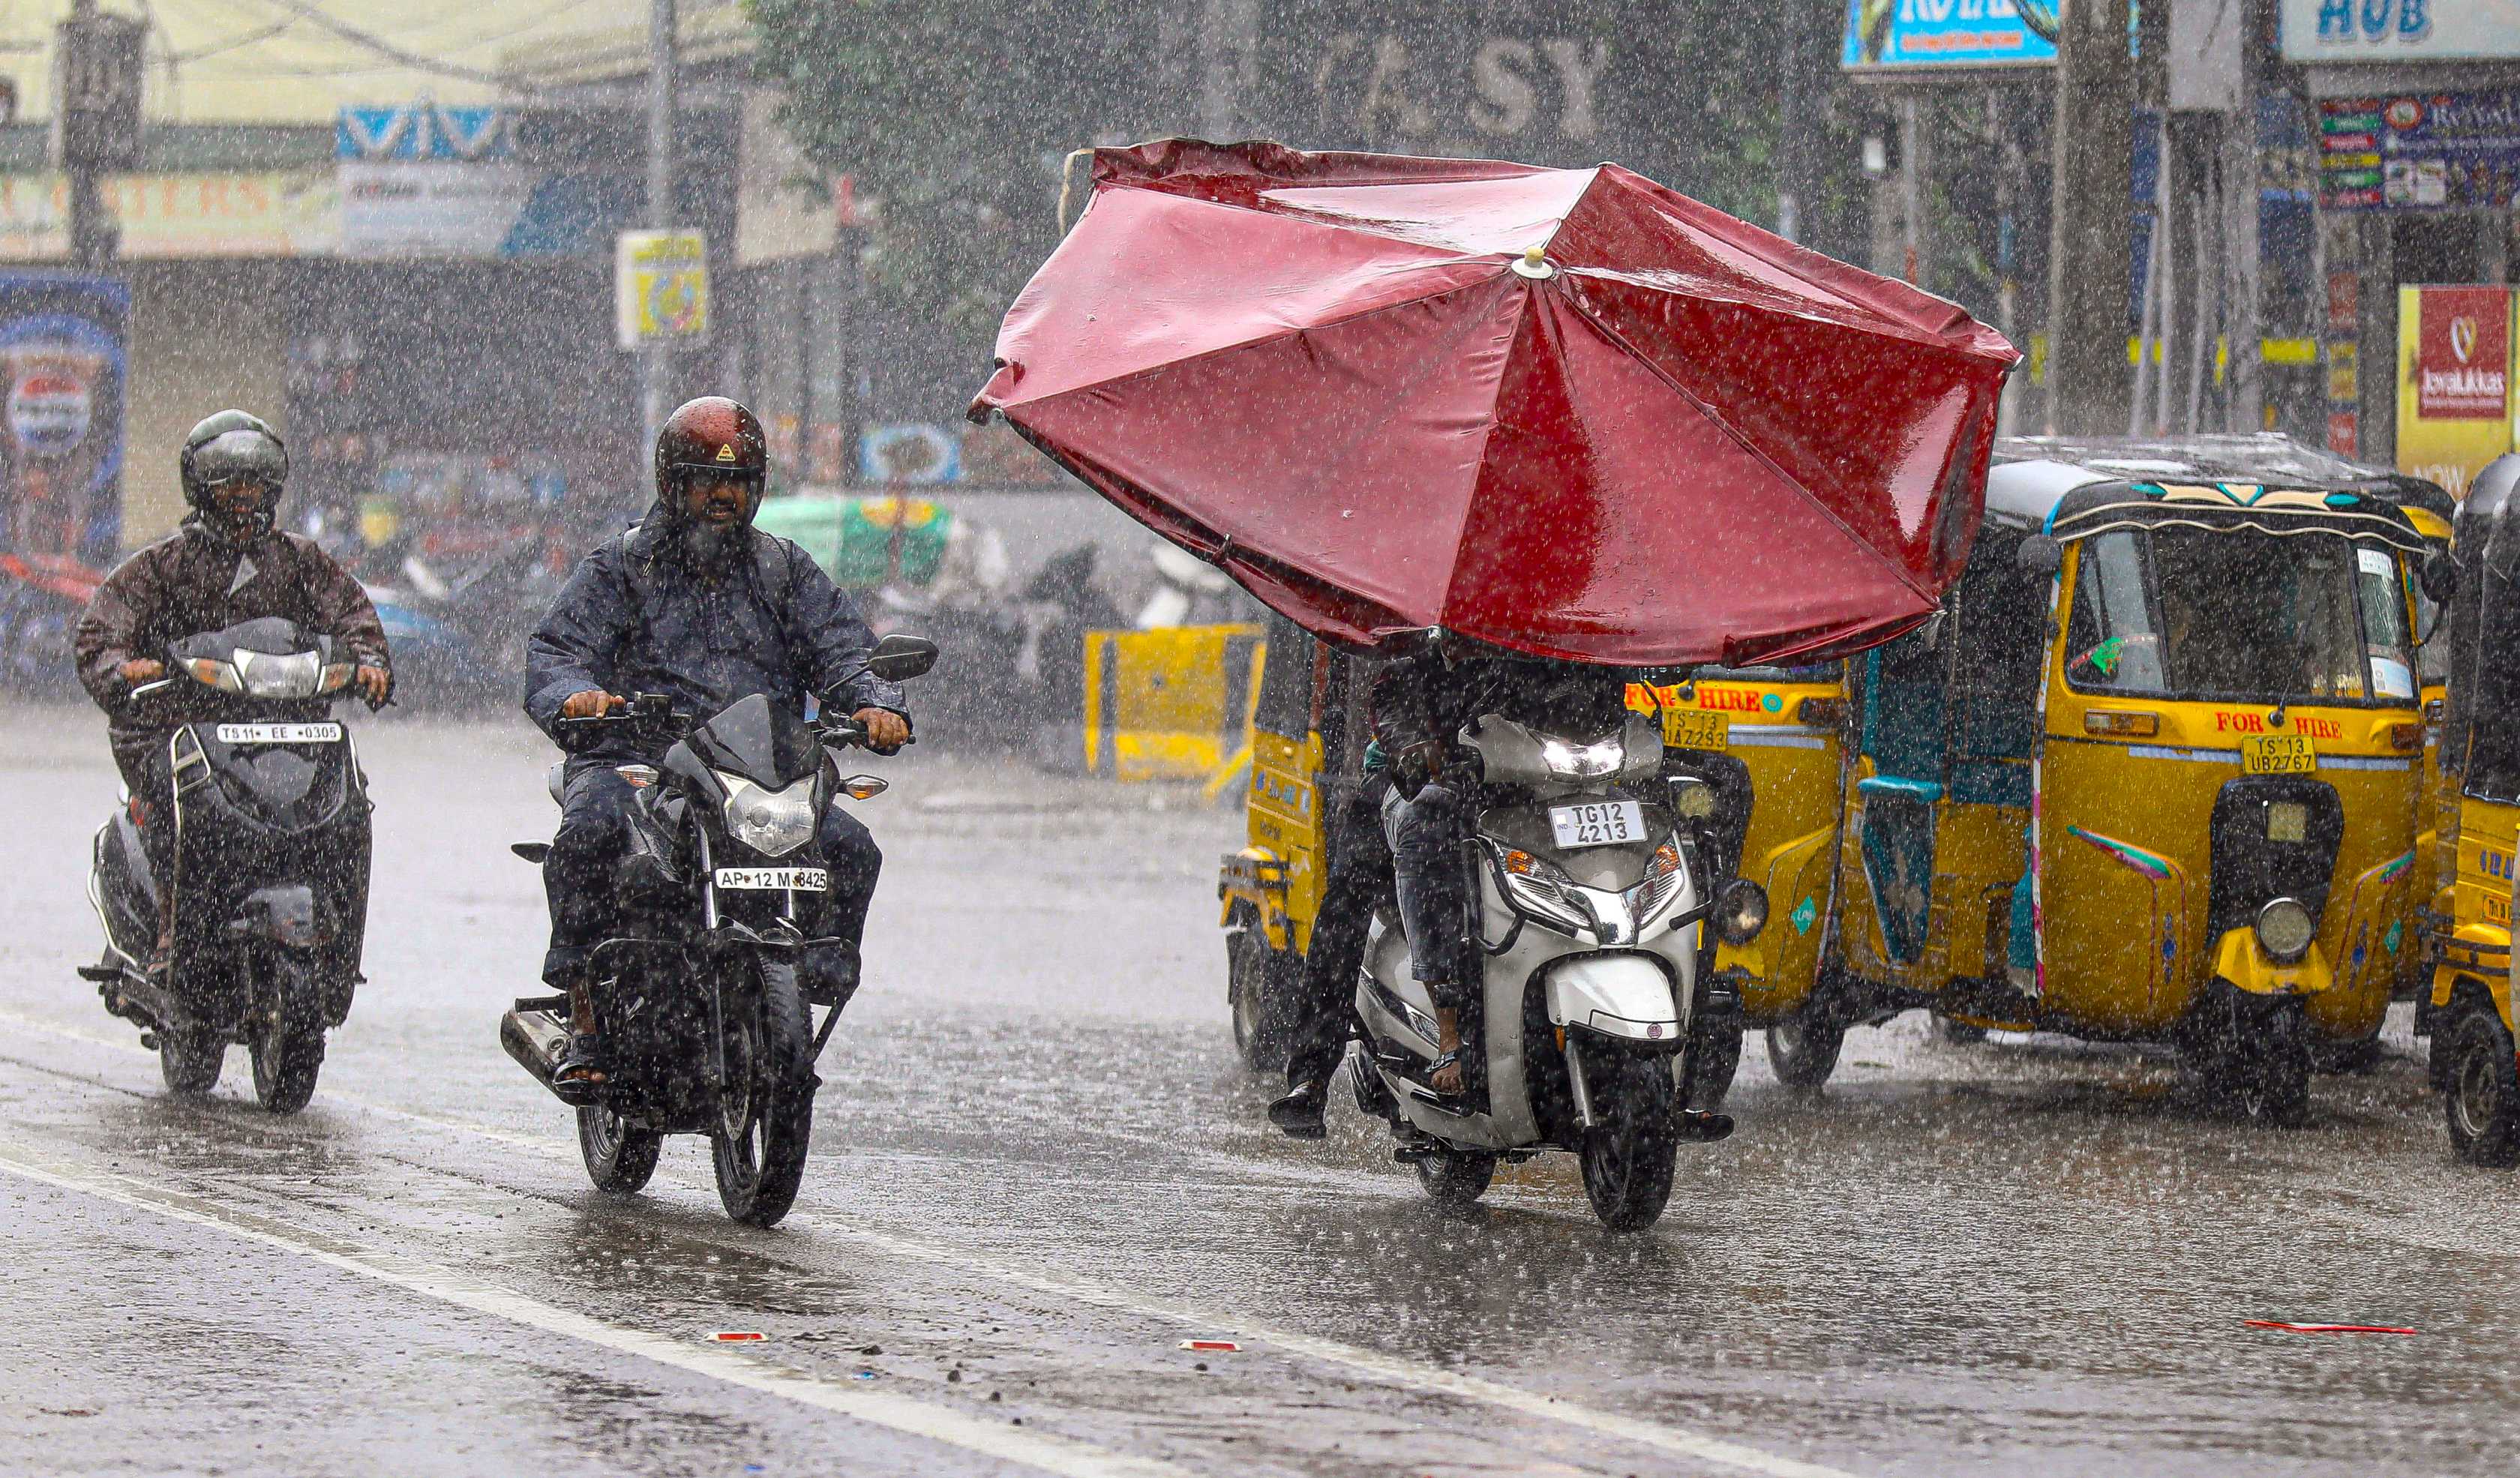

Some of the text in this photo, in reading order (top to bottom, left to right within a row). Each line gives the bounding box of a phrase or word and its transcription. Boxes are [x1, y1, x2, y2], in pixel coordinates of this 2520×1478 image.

[2317, 0, 2432, 40] HUB
[1626, 685, 1760, 712] FOR HIRE
[272, 727, 288, 739] EE
[305, 726, 337, 739] 0305
[2215, 712, 2342, 739] FOR HIRE
[2251, 754, 2312, 771] UB2767
[1572, 803, 1624, 824] TG12
[1578, 823, 1628, 843] 4213
[722, 872, 743, 886] AP
[754, 872, 772, 887] 12
[777, 872, 790, 887] M
